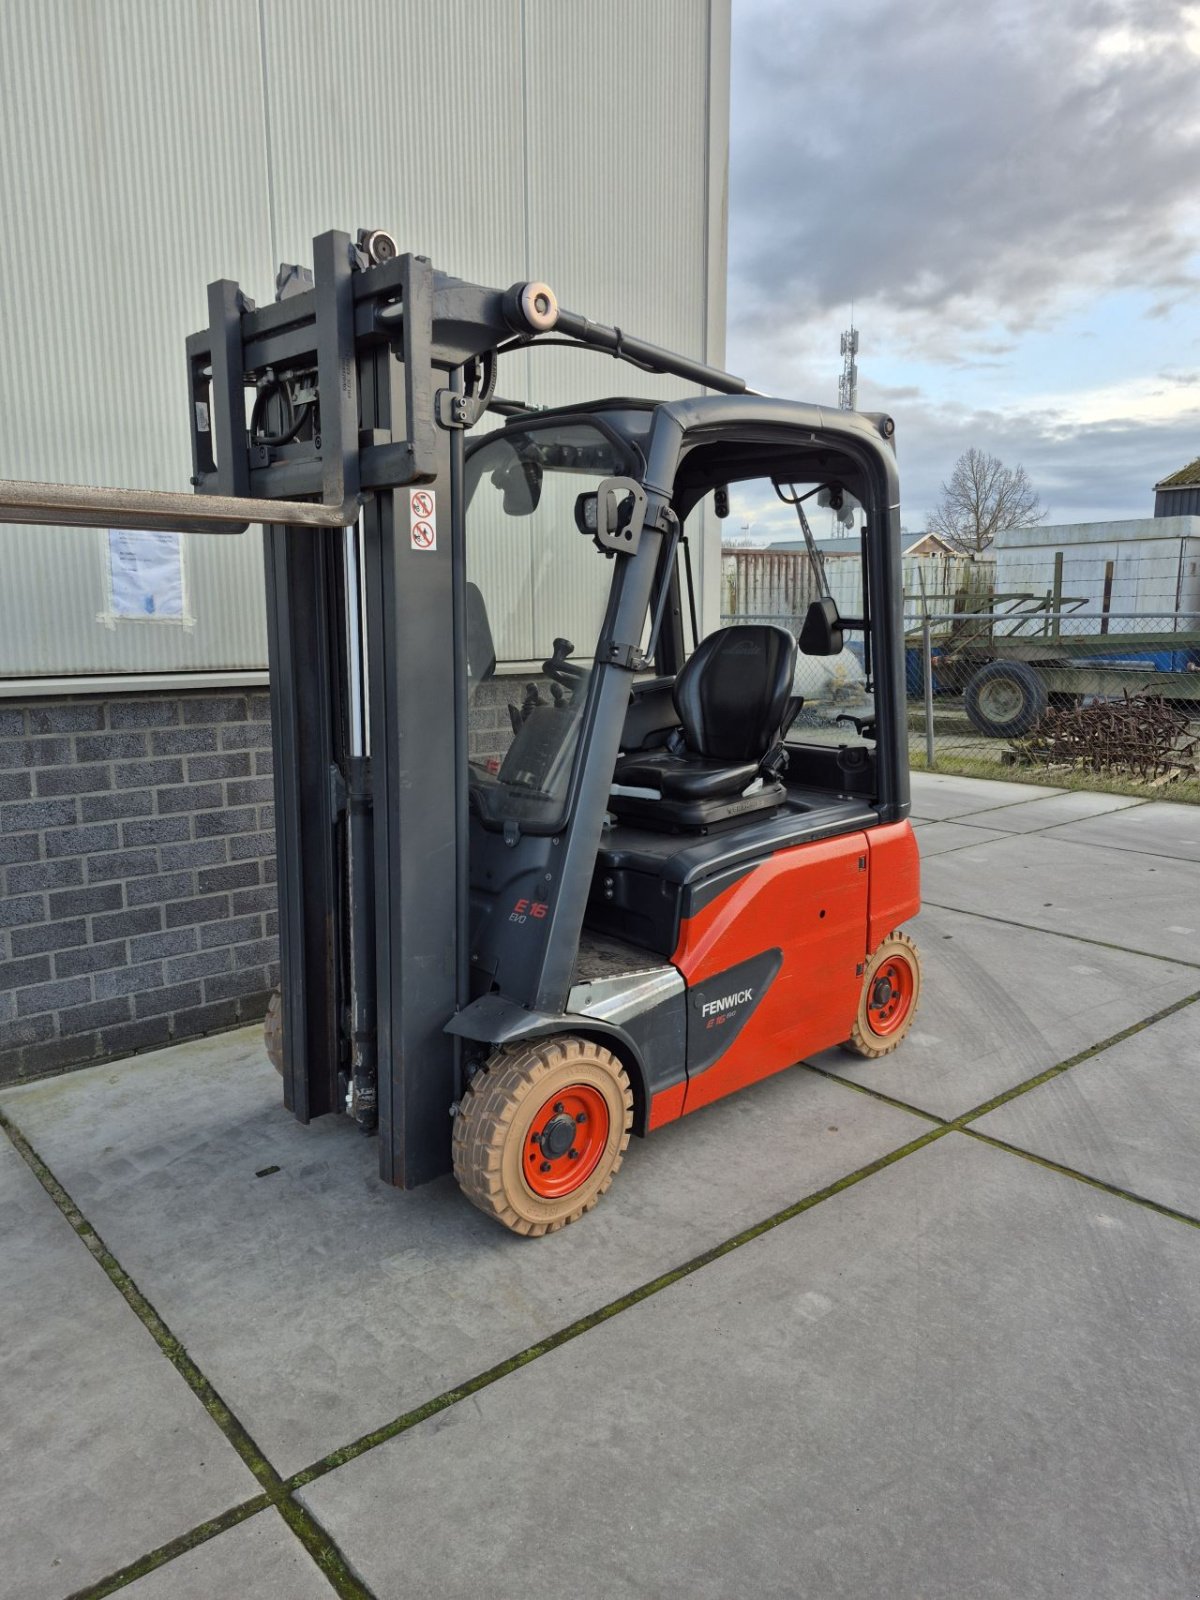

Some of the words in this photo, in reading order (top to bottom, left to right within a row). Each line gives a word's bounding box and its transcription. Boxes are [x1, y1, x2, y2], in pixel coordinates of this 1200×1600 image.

[514, 898, 529, 913] E
[529, 902, 548, 918] 16
[509, 912, 527, 924] EVO
[702, 988, 752, 1018] FENWICK
[706, 1018, 715, 1029] E
[715, 1015, 726, 1025] 16
